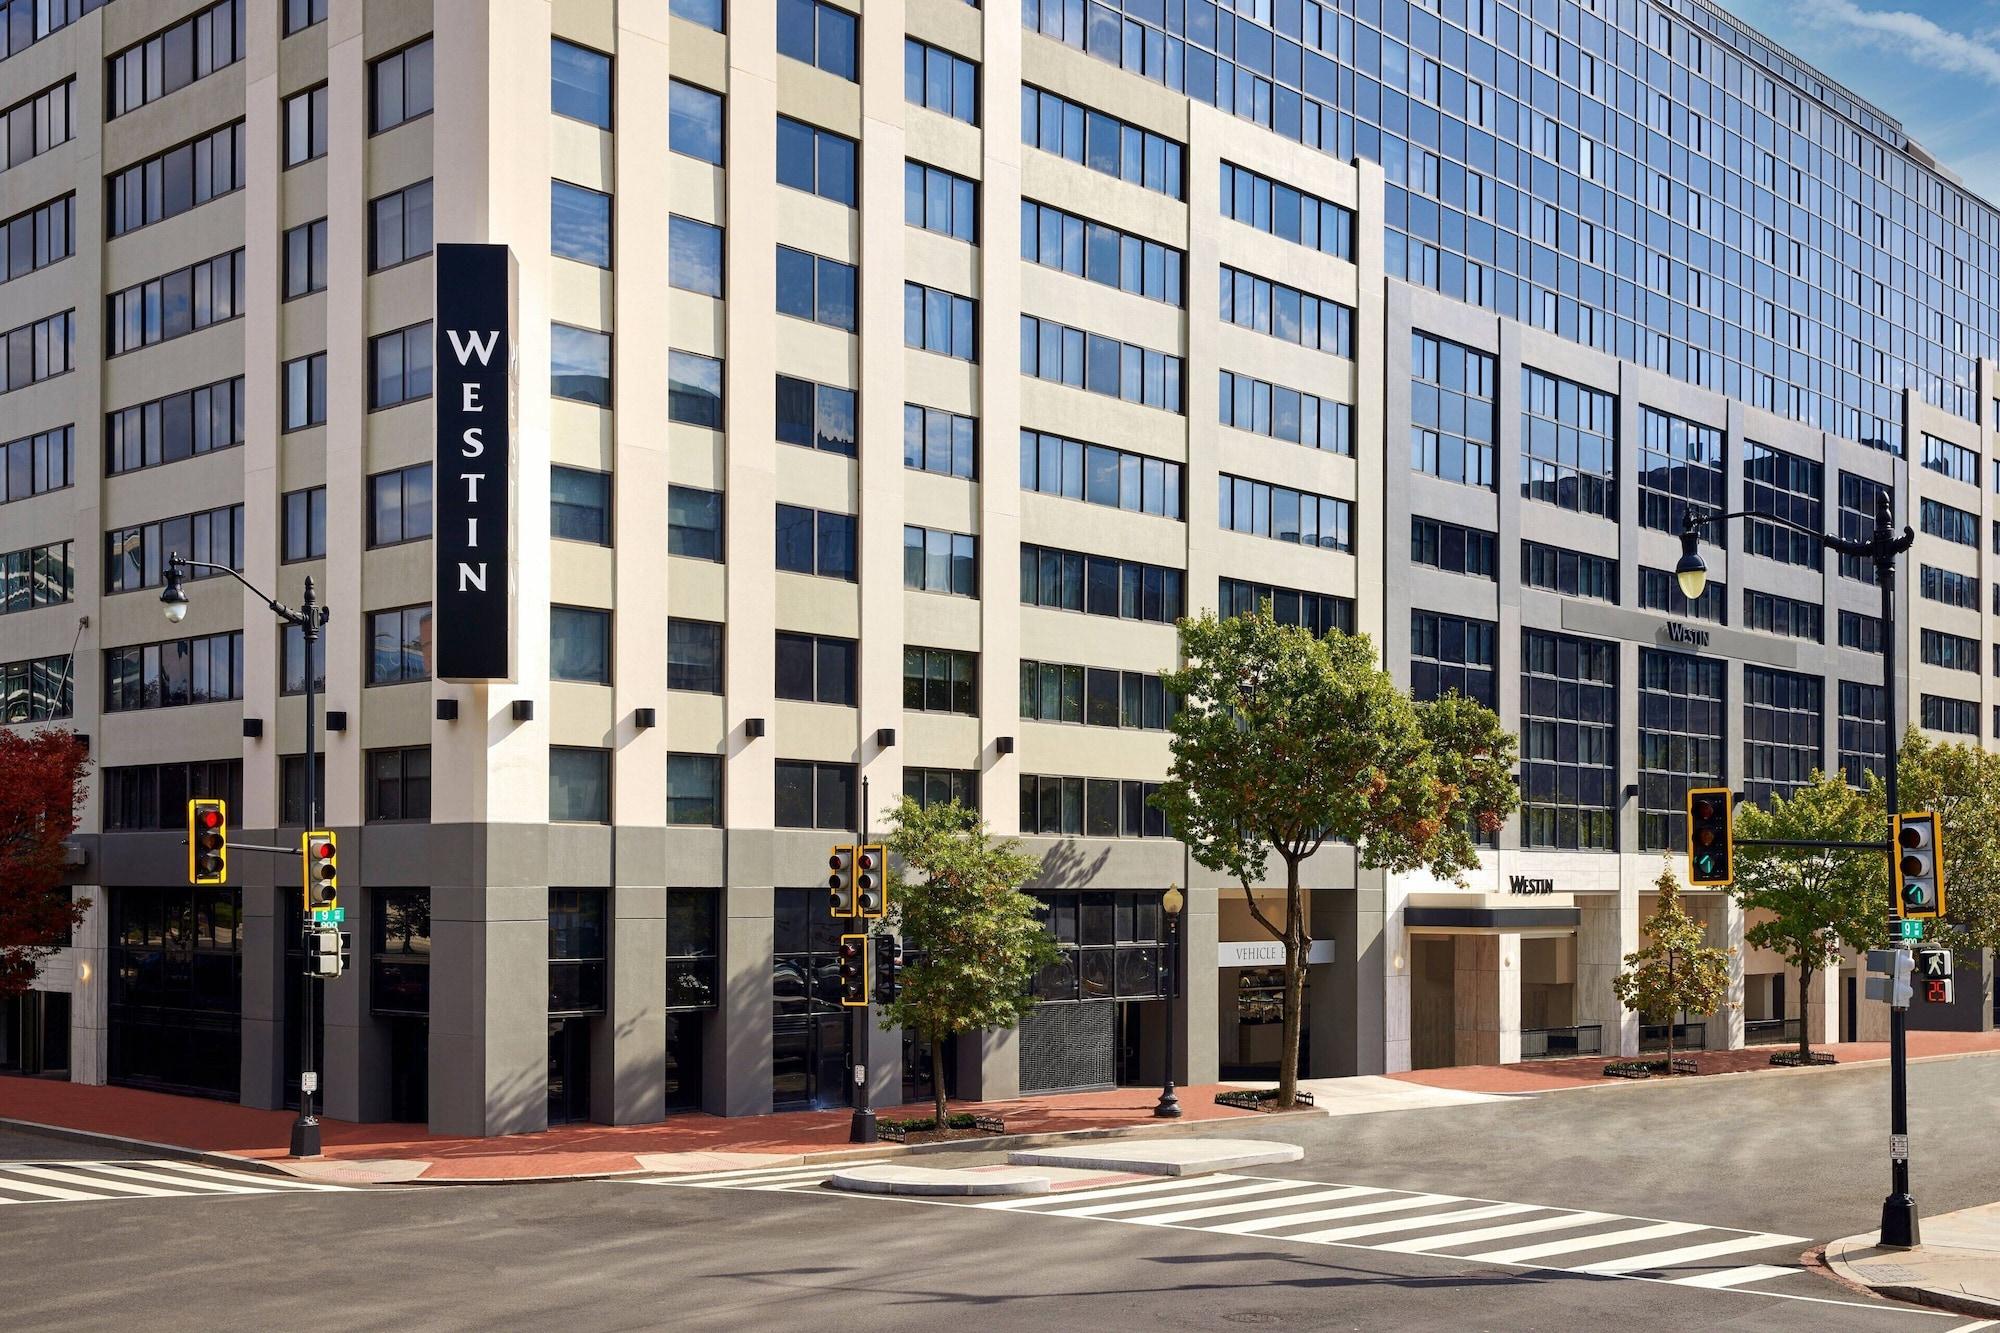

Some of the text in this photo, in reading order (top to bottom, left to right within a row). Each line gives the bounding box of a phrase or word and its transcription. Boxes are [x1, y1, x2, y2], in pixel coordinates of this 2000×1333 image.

[446, 330, 500, 592] WESTIN
[1667, 621, 1710, 647] WESTIN
[1509, 875, 1553, 894] WESTIN
[321, 911, 329, 921] 9
[1904, 922, 1911, 936] 9
[1236, 946, 1276, 960] VEHICLE
[1928, 981, 1946, 1002] 25
